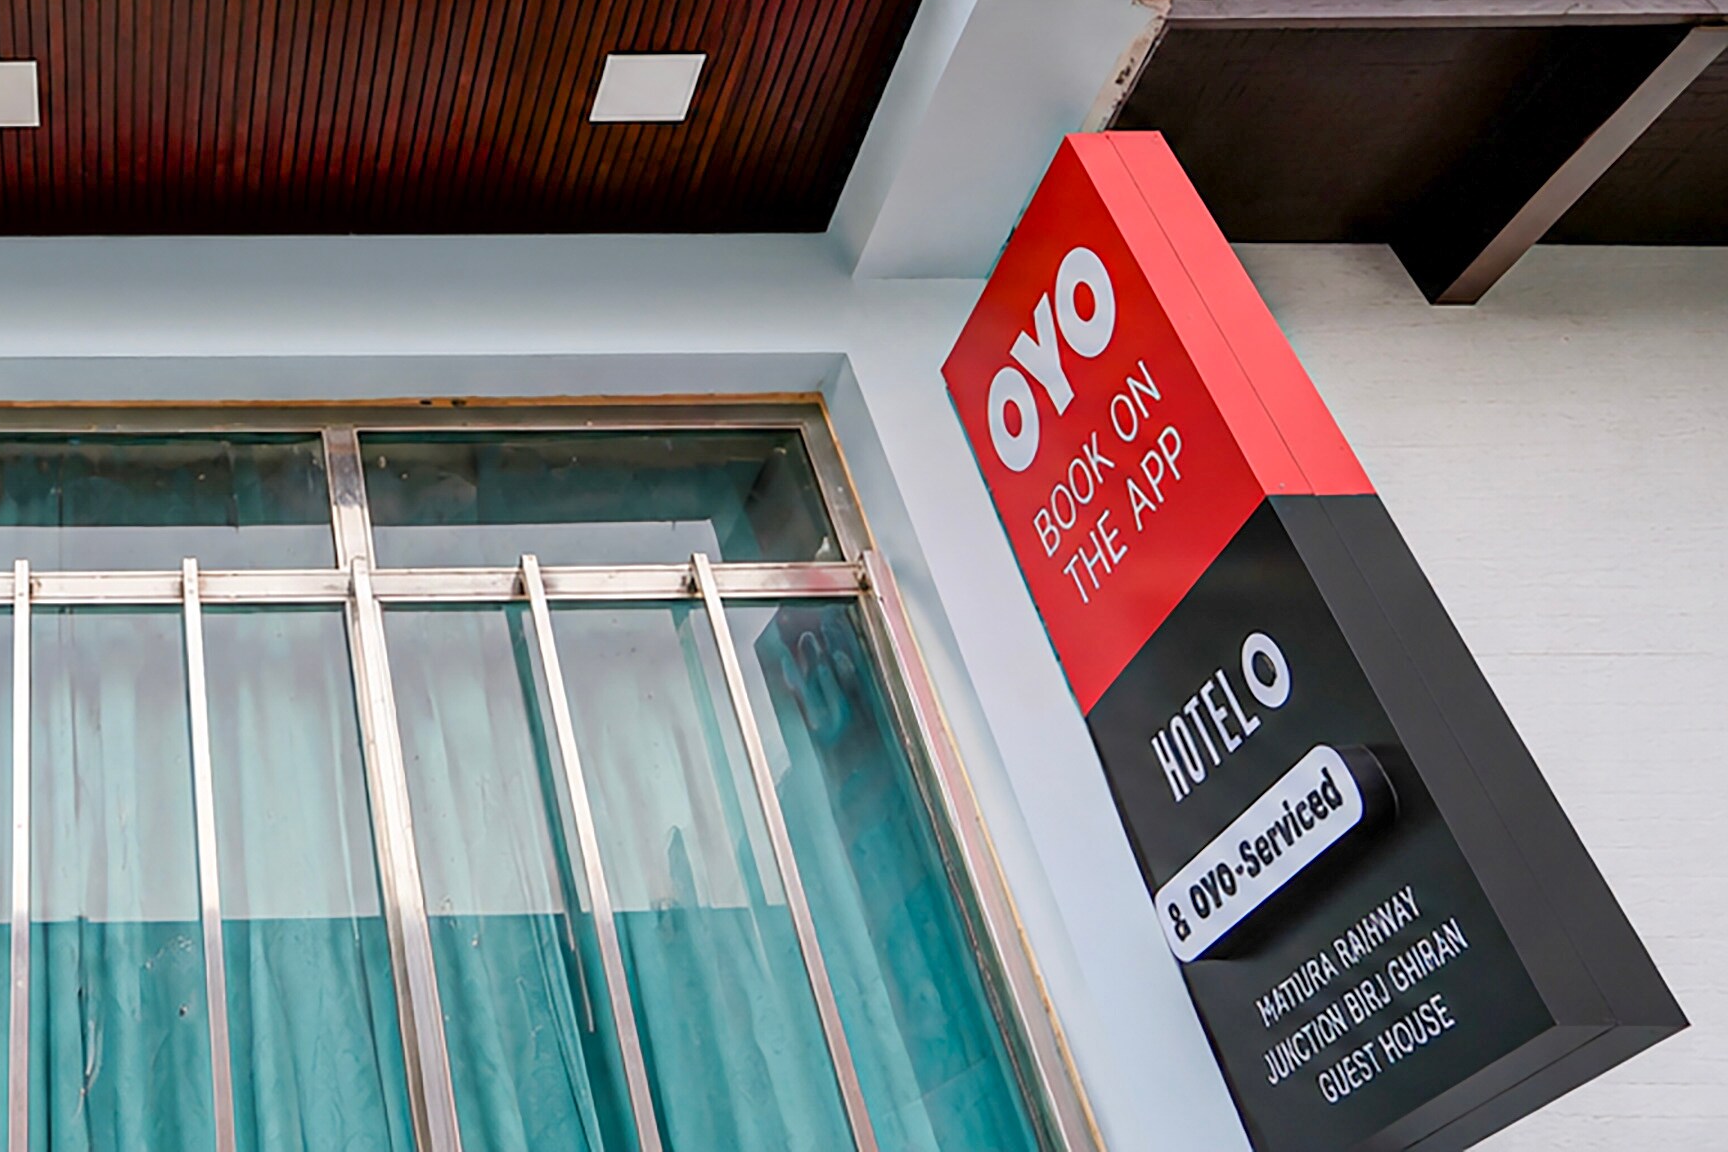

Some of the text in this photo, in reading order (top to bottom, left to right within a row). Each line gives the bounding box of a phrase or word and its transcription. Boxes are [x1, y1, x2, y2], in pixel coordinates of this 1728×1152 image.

[987, 246, 1116, 472] OYO
[1033, 360, 1161, 557] BOOK ON
[1063, 425, 1183, 603] THE APP
[1168, 766, 1344, 942] & OYO-Serviced
[1255, 885, 1421, 1028] MATIURA RAIHWAY
[1343, 973, 1392, 1025] BIRJ
[1318, 994, 1456, 1103] GUEST HOUSE
